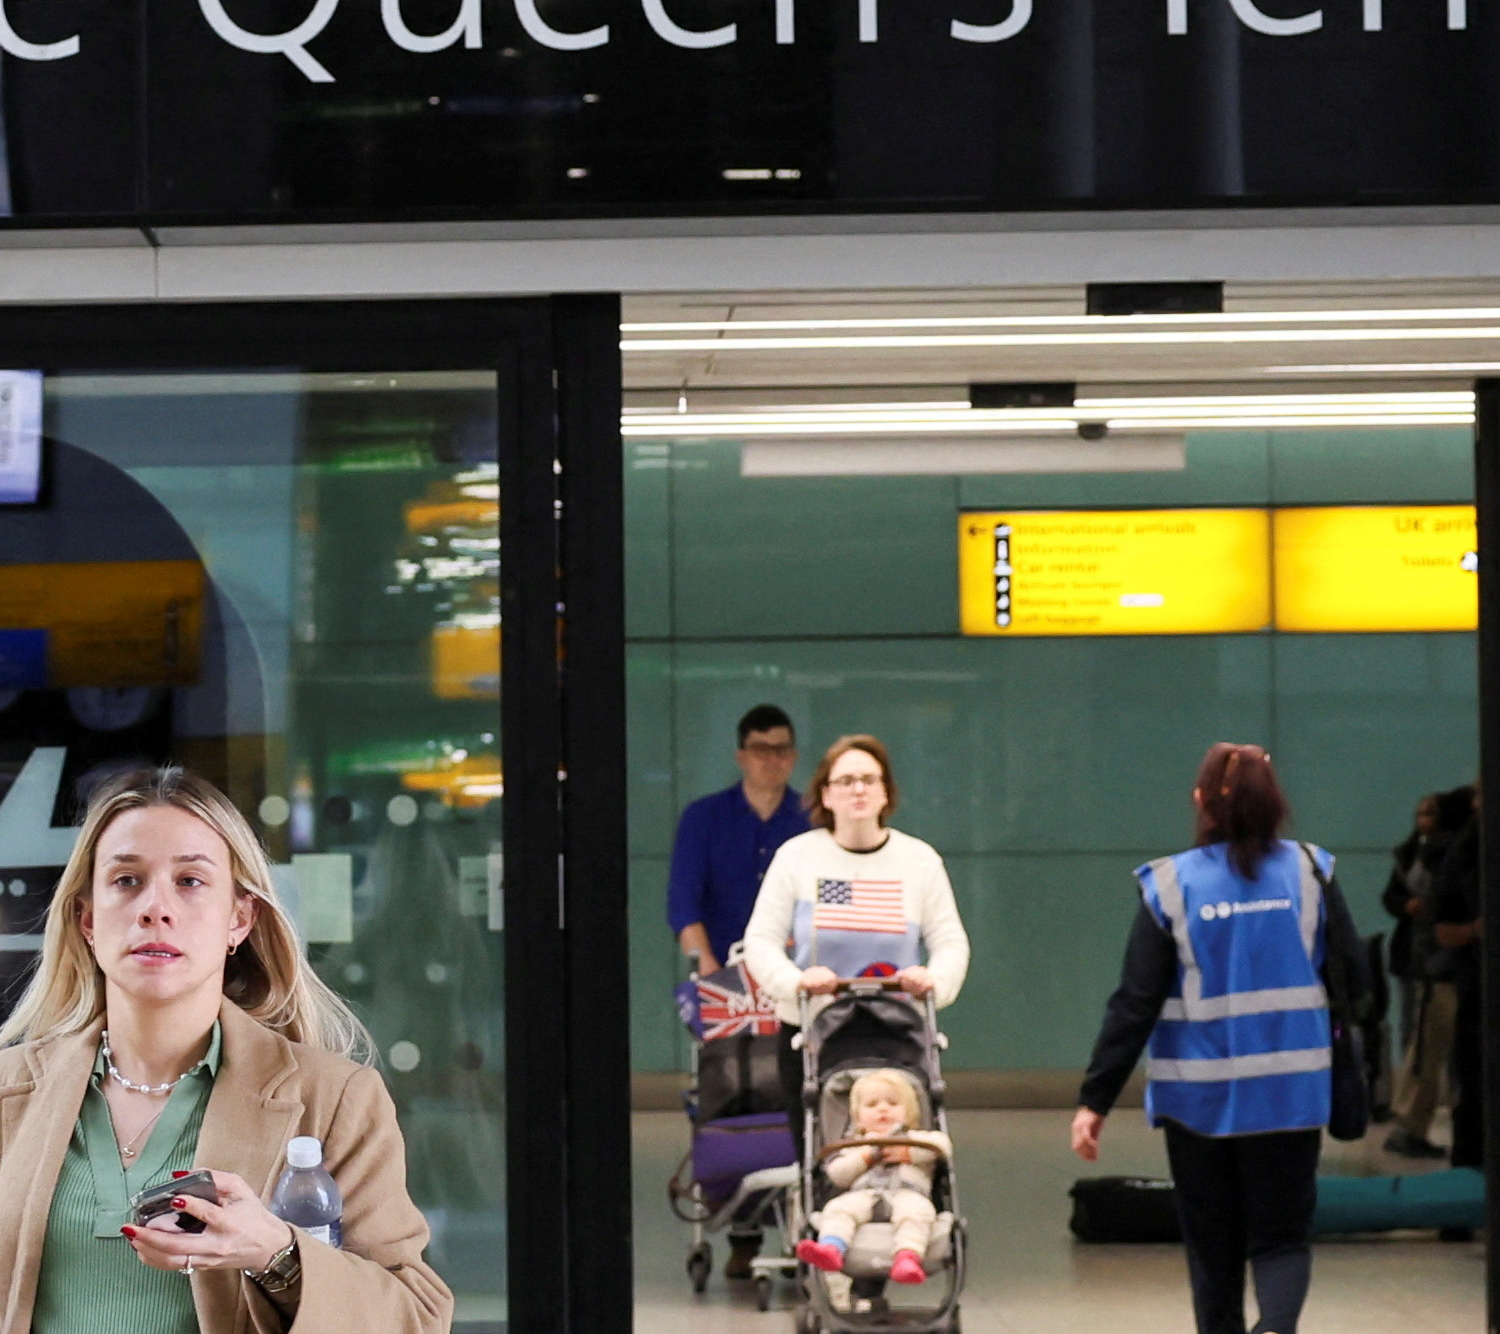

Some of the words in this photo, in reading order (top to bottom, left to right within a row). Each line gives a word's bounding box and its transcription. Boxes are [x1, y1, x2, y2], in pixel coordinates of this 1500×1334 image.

[1016, 520, 1129, 536] International
[1133, 520, 1197, 536] arrivals
[1394, 516, 1427, 534] UK
[1433, 516, 1477, 534] arri
[728, 988, 776, 1017] M&
